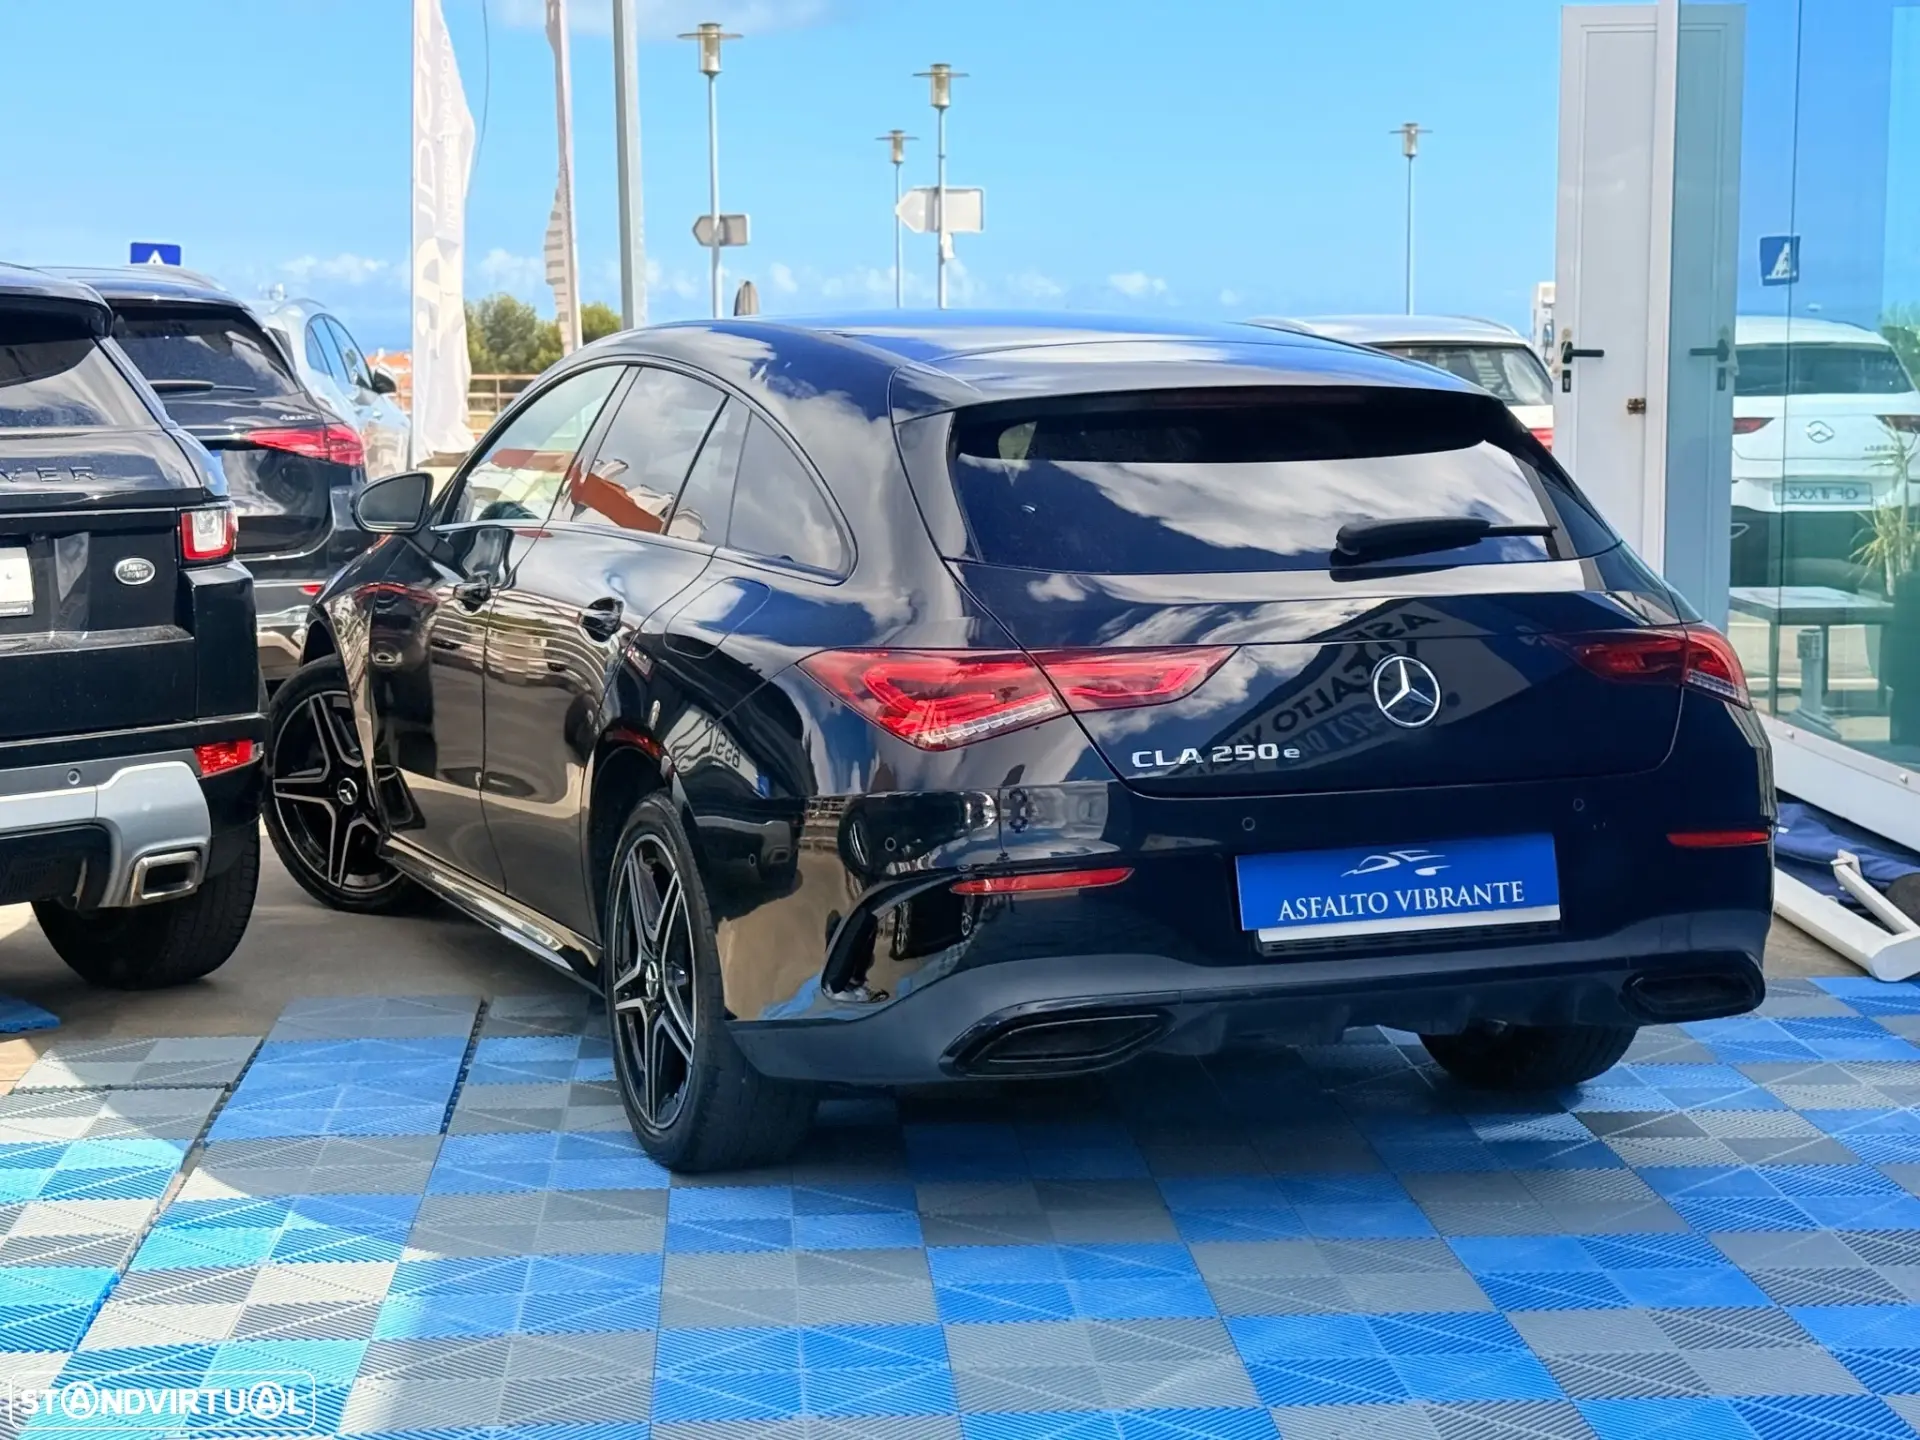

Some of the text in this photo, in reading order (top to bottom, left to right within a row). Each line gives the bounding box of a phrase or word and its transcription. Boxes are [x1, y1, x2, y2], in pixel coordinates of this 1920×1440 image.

[1131, 743, 1300, 768] CLA 250 e
[1277, 880, 1525, 922] ASFALTO VIBRANTE
